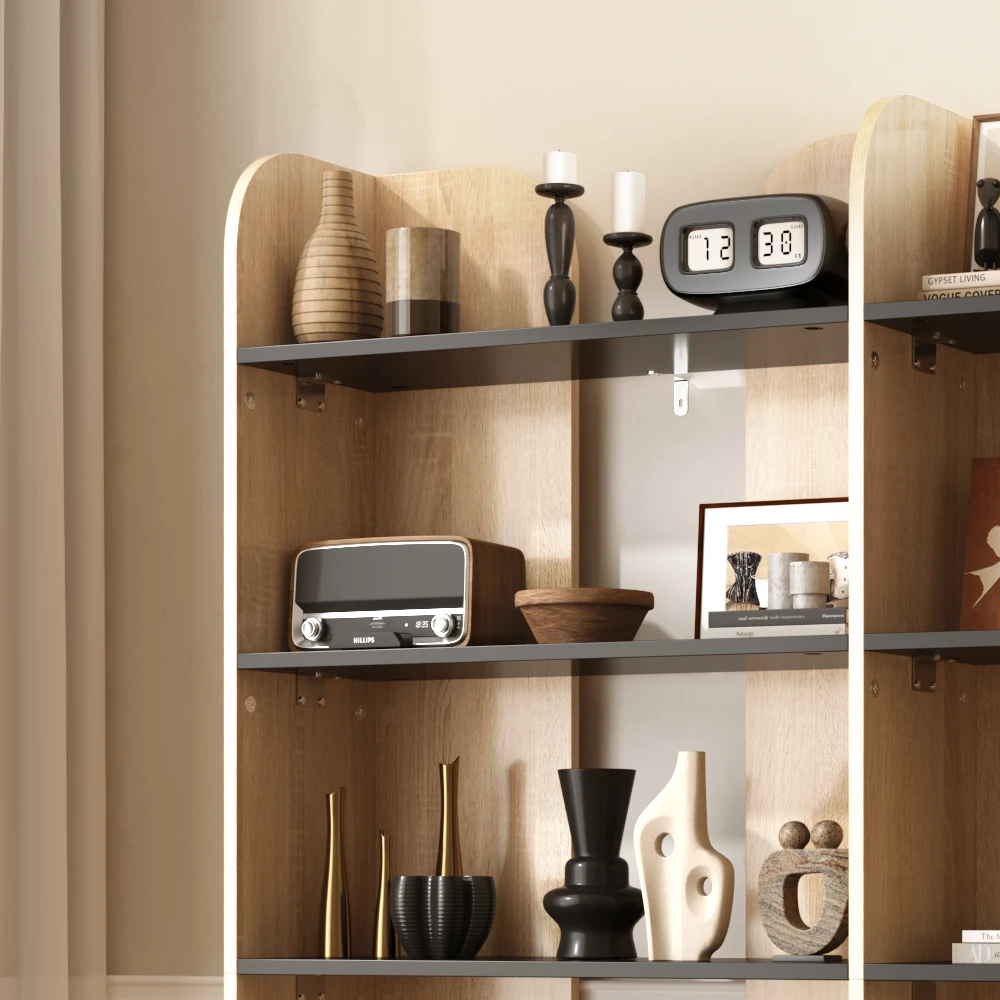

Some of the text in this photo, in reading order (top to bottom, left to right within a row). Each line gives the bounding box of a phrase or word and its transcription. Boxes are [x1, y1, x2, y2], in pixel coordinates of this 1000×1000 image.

[927, 273, 986, 286] GYPSET LIVING
[981, 932, 995, 940] The
[968, 944, 992, 964] AD
